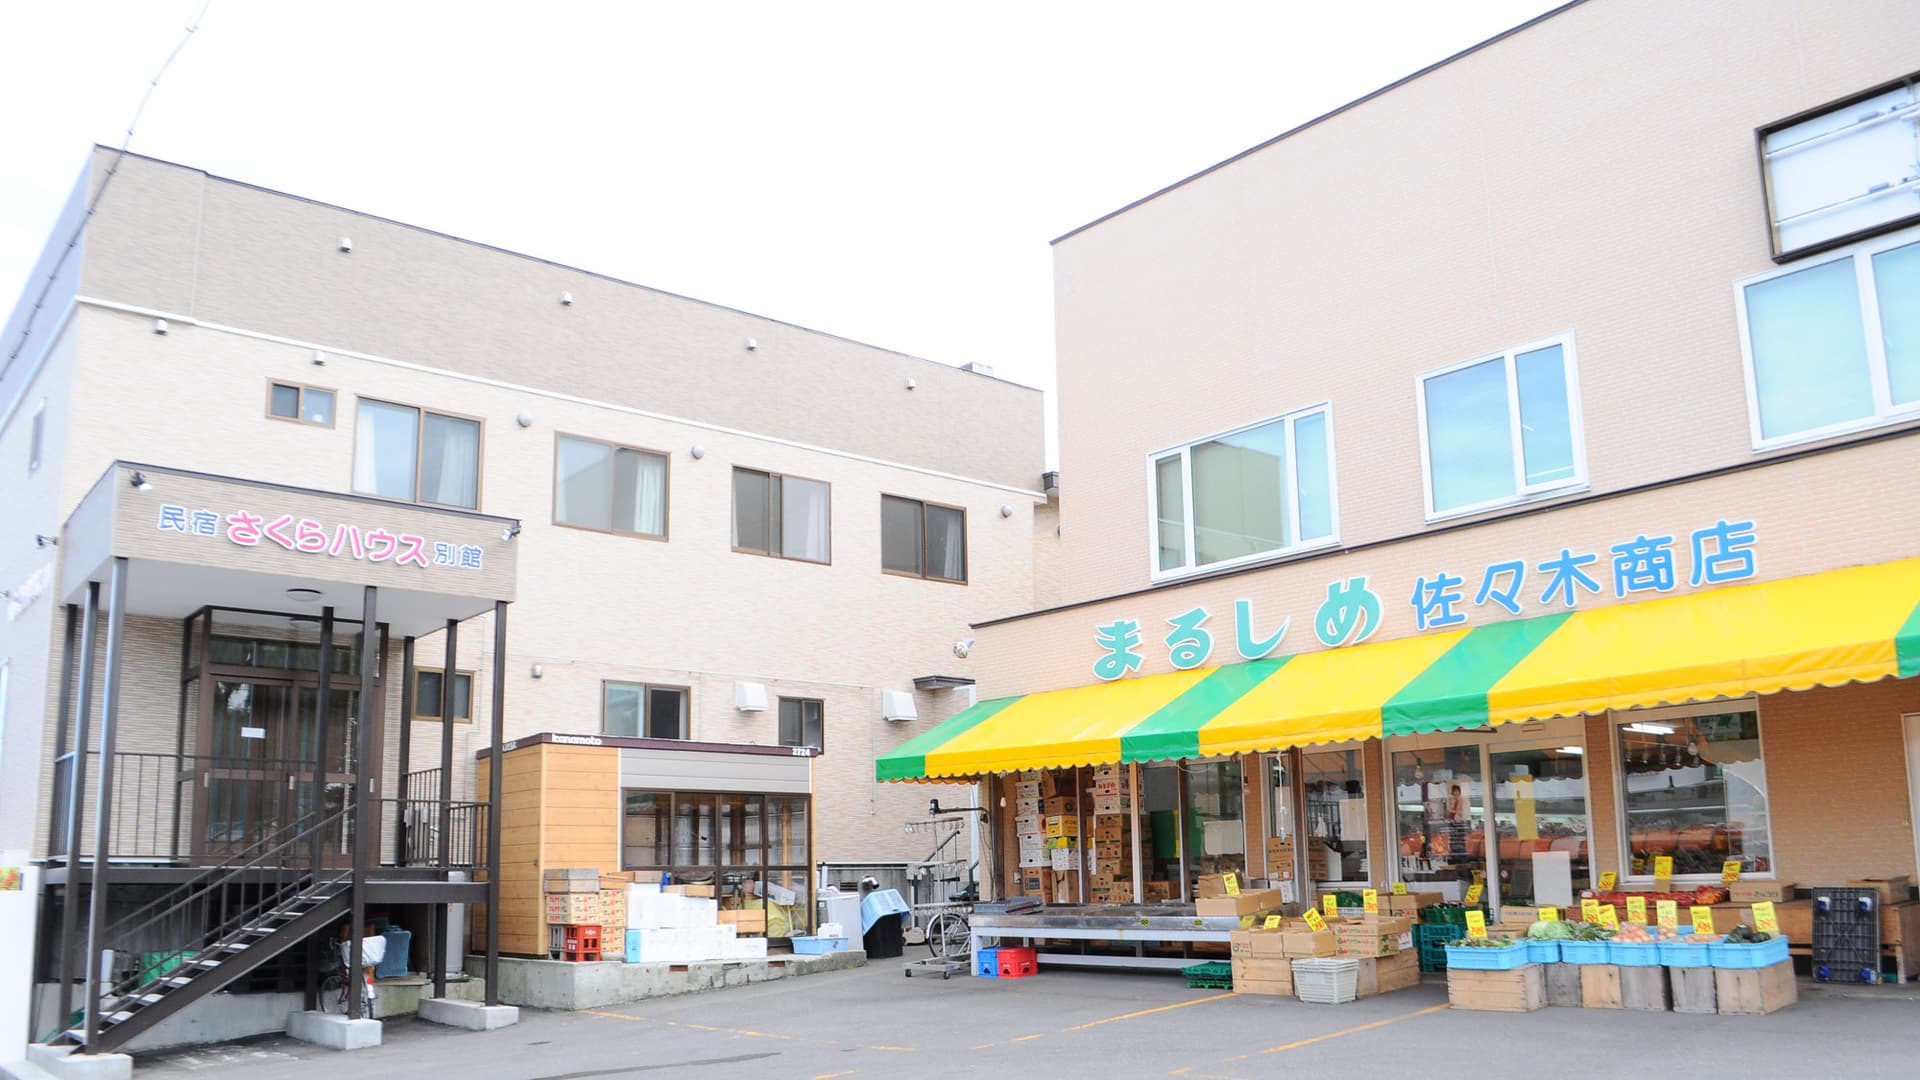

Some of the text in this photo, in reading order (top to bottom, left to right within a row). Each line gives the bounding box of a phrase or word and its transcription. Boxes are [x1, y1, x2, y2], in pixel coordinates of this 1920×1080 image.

[158, 505, 483, 569] 民宿 さくらハウス 別館
[1093, 519, 1758, 681] まるしめ 佐々木商店
